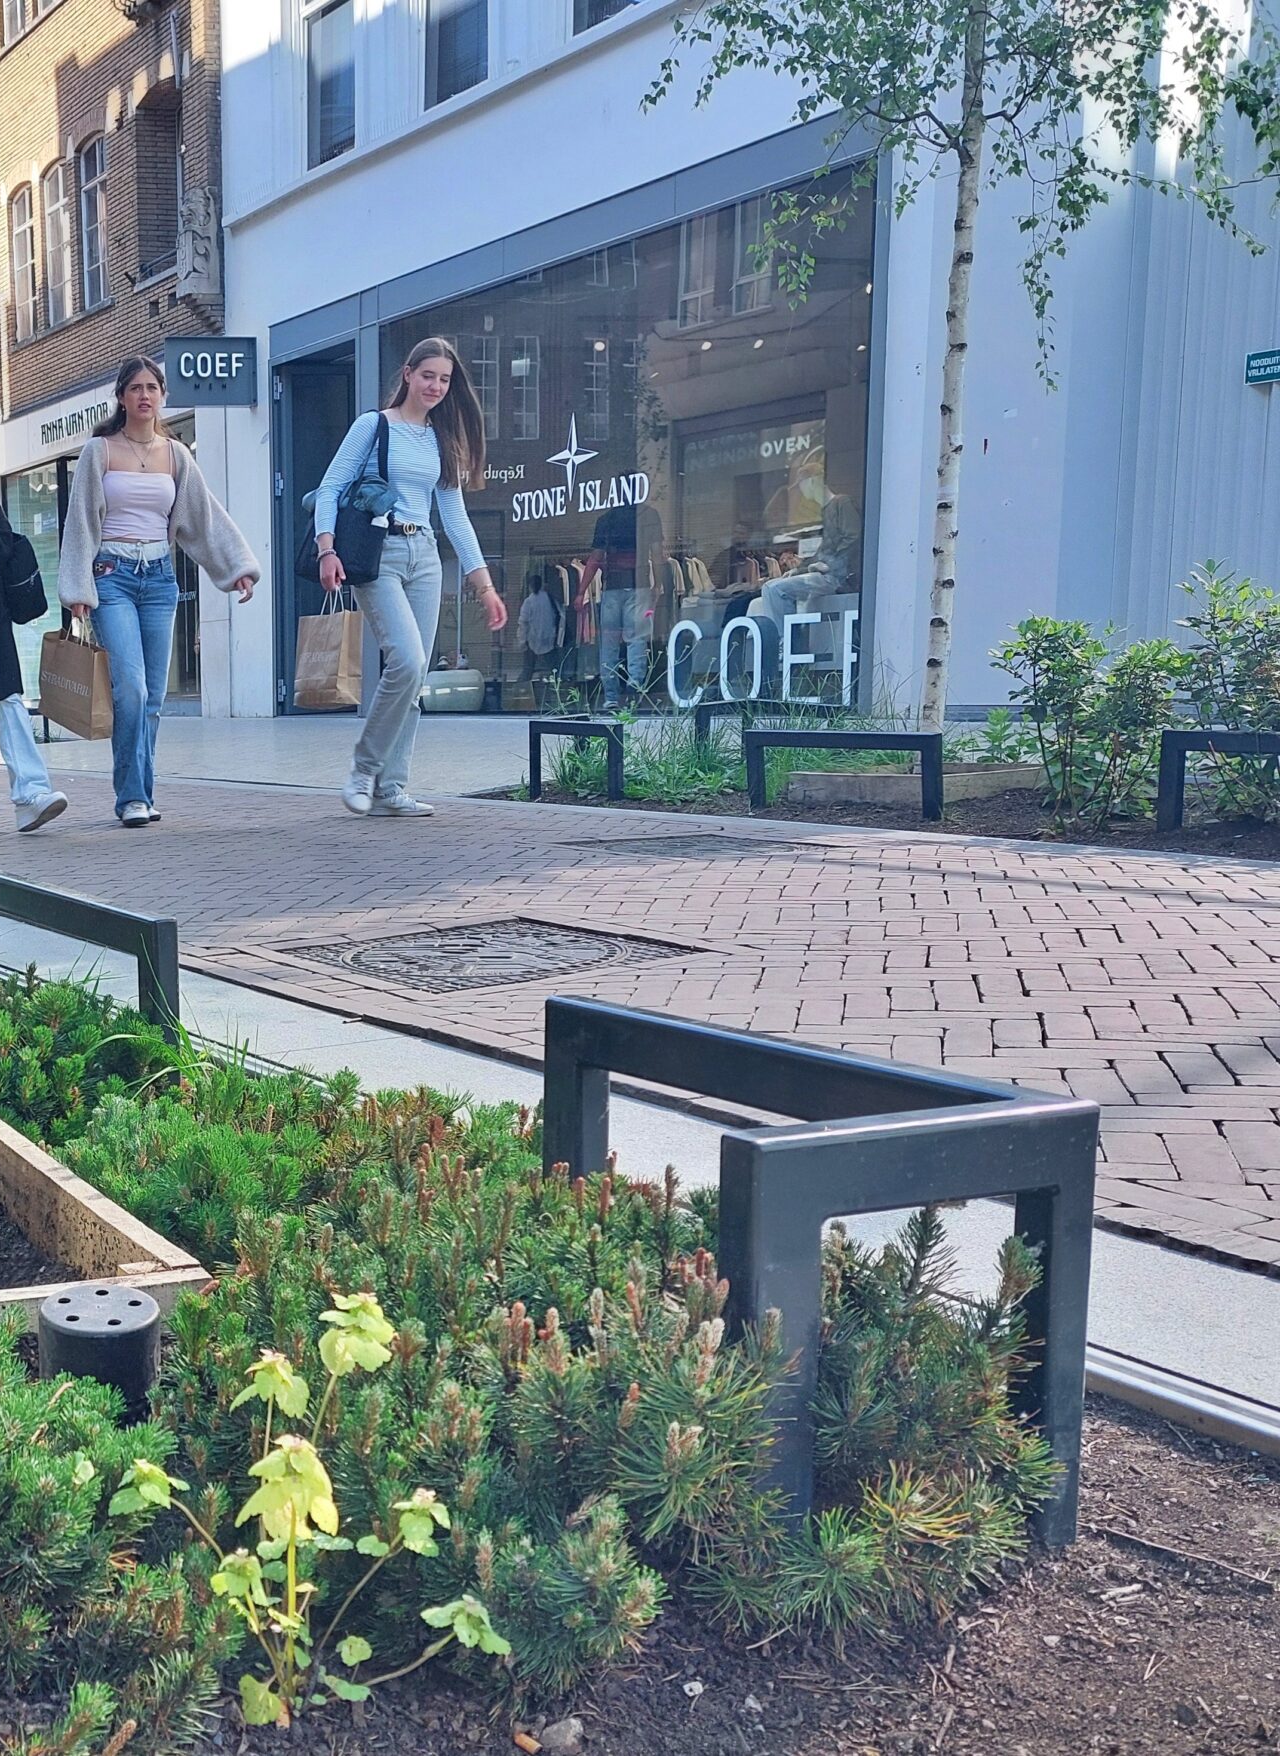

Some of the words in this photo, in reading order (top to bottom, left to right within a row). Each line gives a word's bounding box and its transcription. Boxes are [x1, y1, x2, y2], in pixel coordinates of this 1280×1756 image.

[180, 352, 245, 378] COEF
[1250, 355, 1280, 368] NOODUIT
[41, 417, 65, 446] ANNA
[64, 409, 85, 437] VAN
[85, 401, 109, 430] TOOR
[512, 485, 567, 523] STONE
[578, 472, 650, 513] ISLAND
[667, 609, 859, 708] COEF
[40, 670, 91, 697] STRADIVARIU
